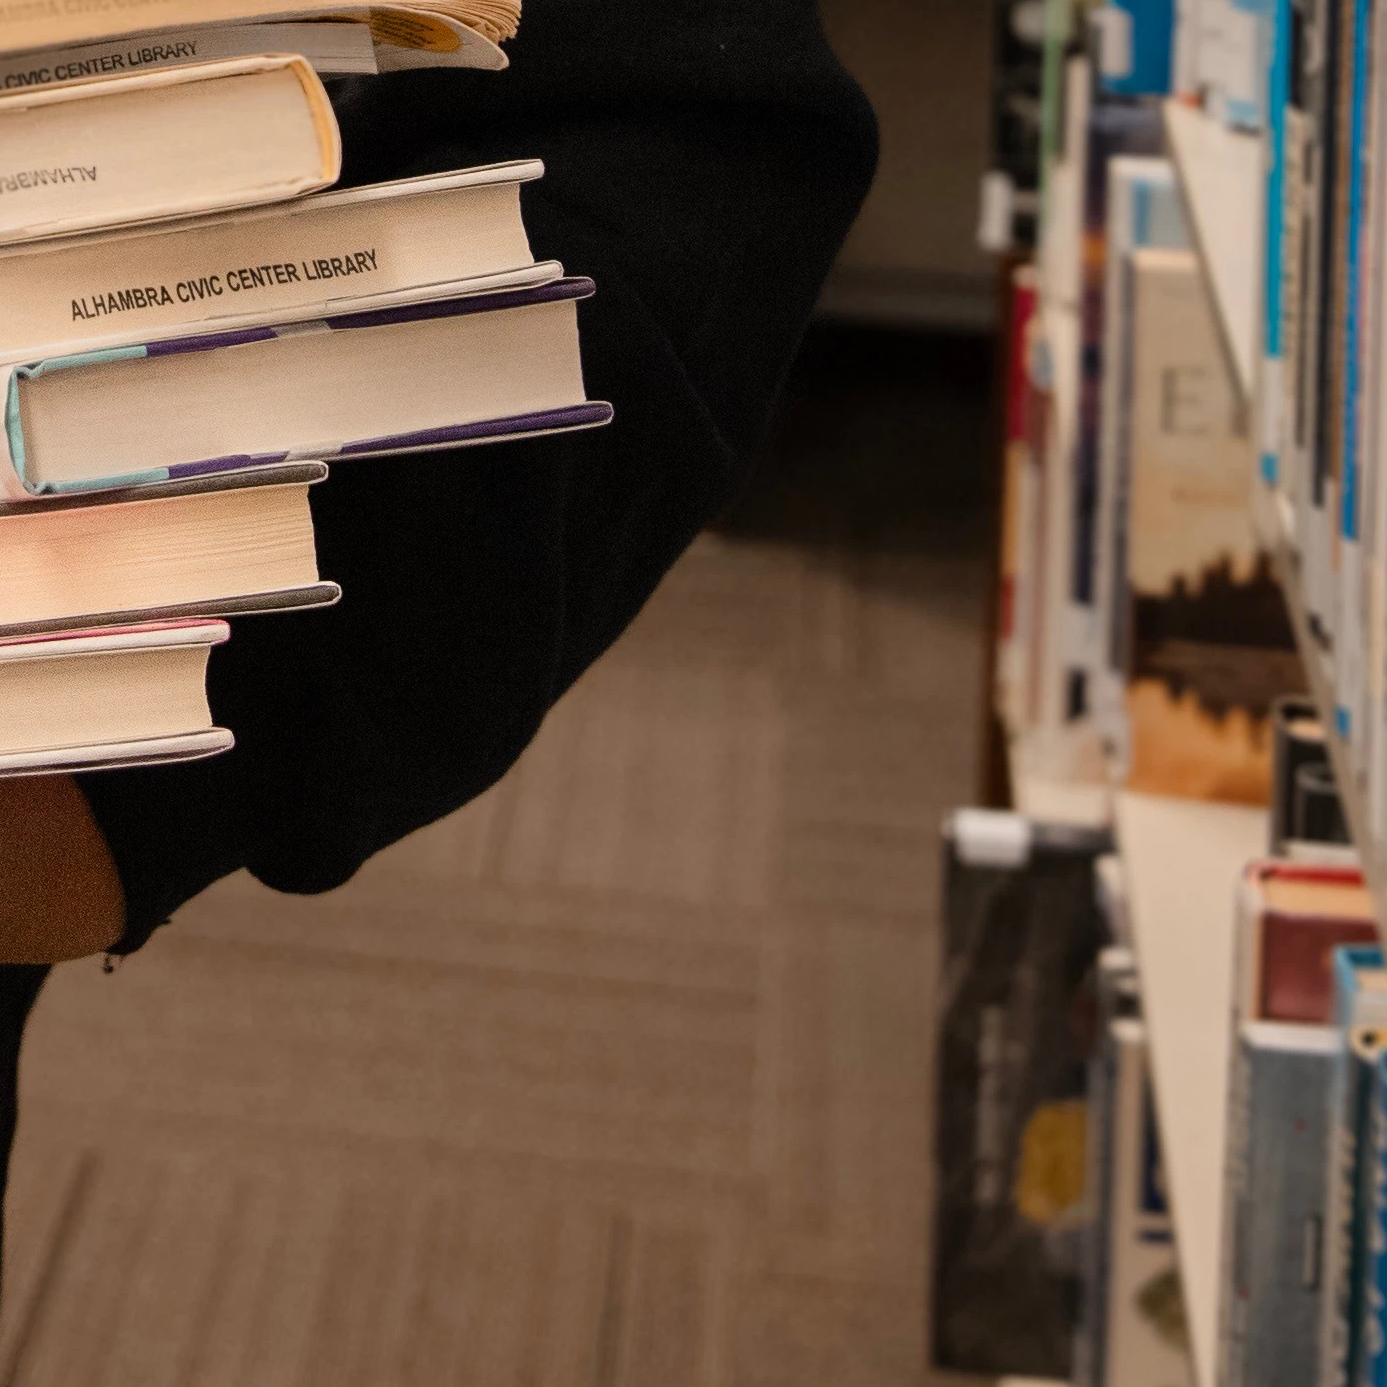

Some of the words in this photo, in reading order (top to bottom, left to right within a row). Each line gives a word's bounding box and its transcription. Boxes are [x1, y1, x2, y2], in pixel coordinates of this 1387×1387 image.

[4, 67, 52, 90] CIVIC
[54, 53, 125, 81] CENTER
[127, 39, 198, 67] LIBRARY
[70, 282, 173, 322] ALHAMBRA
[175, 272, 223, 304] CIVIC
[226, 260, 301, 295] CENTER
[305, 248, 380, 283] LIBRARY
